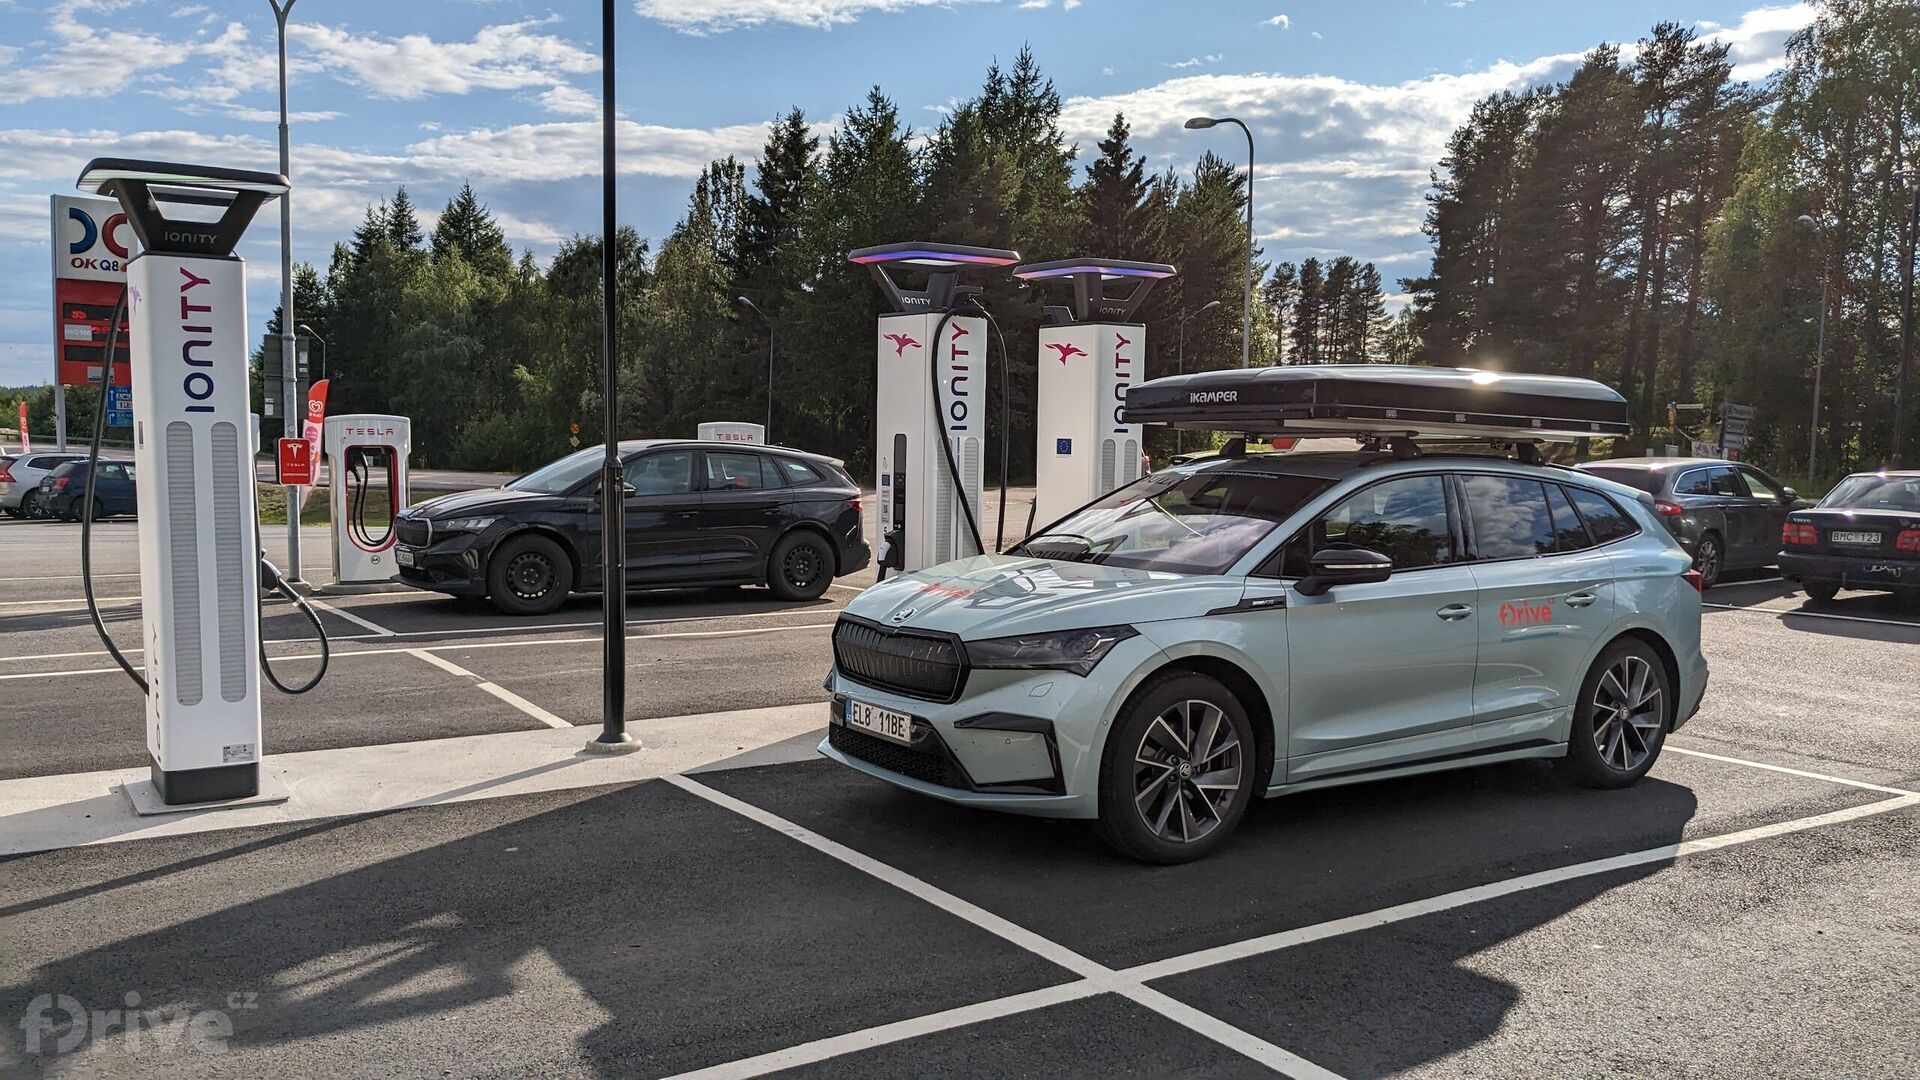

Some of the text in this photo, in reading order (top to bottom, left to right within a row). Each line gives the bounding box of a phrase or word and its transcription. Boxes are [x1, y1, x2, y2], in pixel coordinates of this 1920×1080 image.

[164, 231, 218, 244] IONITY
[901, 296, 931, 305] IONITY
[1099, 306, 1127, 315] IONITY
[179, 266, 215, 413] IONITY
[950, 321, 969, 431] IONITY
[345, 427, 394, 436] TESLA
[716, 433, 753, 441] TESLA
[1833, 532, 1880, 542] BMC 123
[853, 702, 905, 737] EL8 11BE
